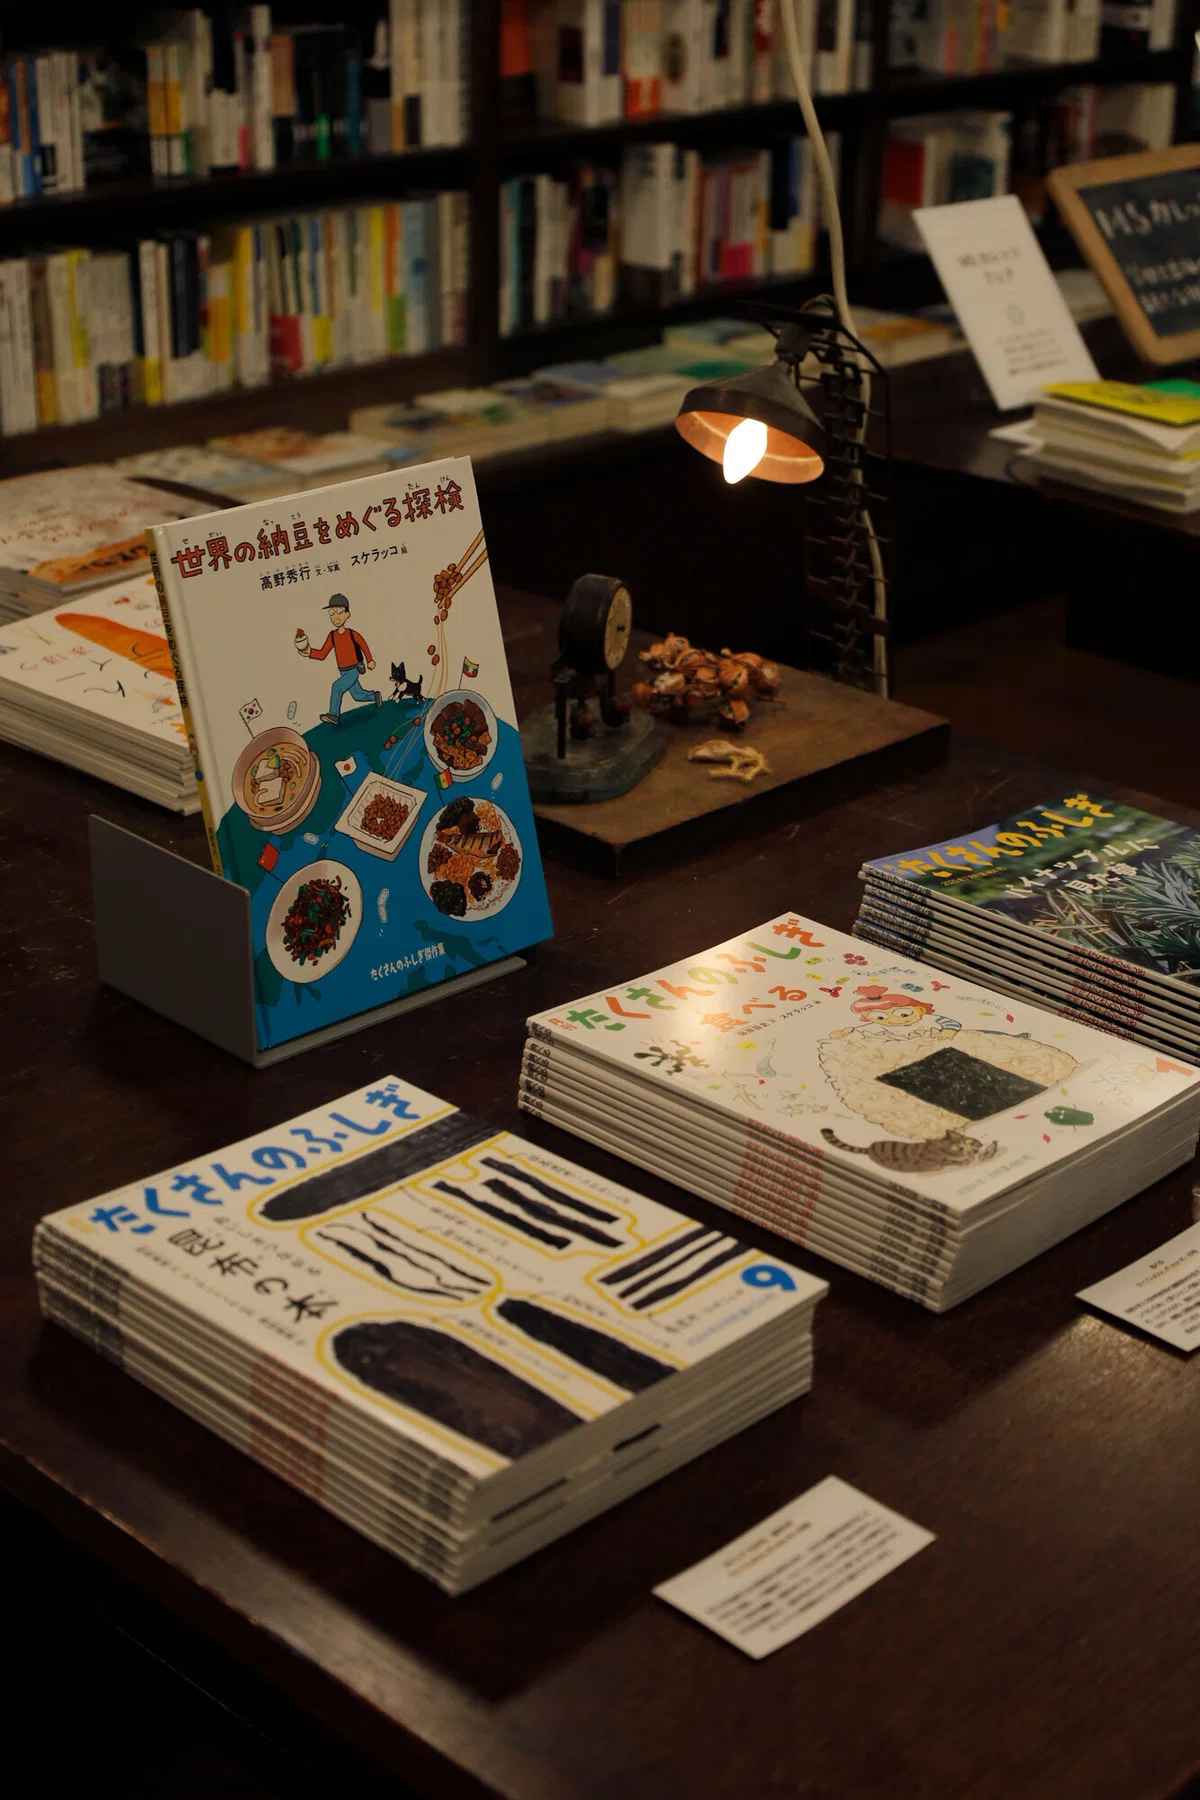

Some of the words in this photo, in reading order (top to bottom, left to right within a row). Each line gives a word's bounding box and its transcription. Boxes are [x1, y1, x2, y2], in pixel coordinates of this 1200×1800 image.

[170, 480, 464, 579] 世界の納豆をめぐる探検
[260, 566, 311, 591] 高野秀行
[351, 546, 398, 566] スケラッコ
[897, 793, 1115, 879] たくさんのふしぎ
[1004, 838, 1160, 898] パイナップルに
[1065, 861, 1138, 895] 見た夢
[370, 941, 446, 981] たくさんのふしぎ傑作集
[566, 918, 825, 1031] たくさんのふしぎ
[699, 985, 808, 1032] 食べる
[89, 1083, 421, 1236] たくさんのふしぎ
[168, 1228, 338, 1324] 昆布の本
[741, 1264, 797, 1293] 9
